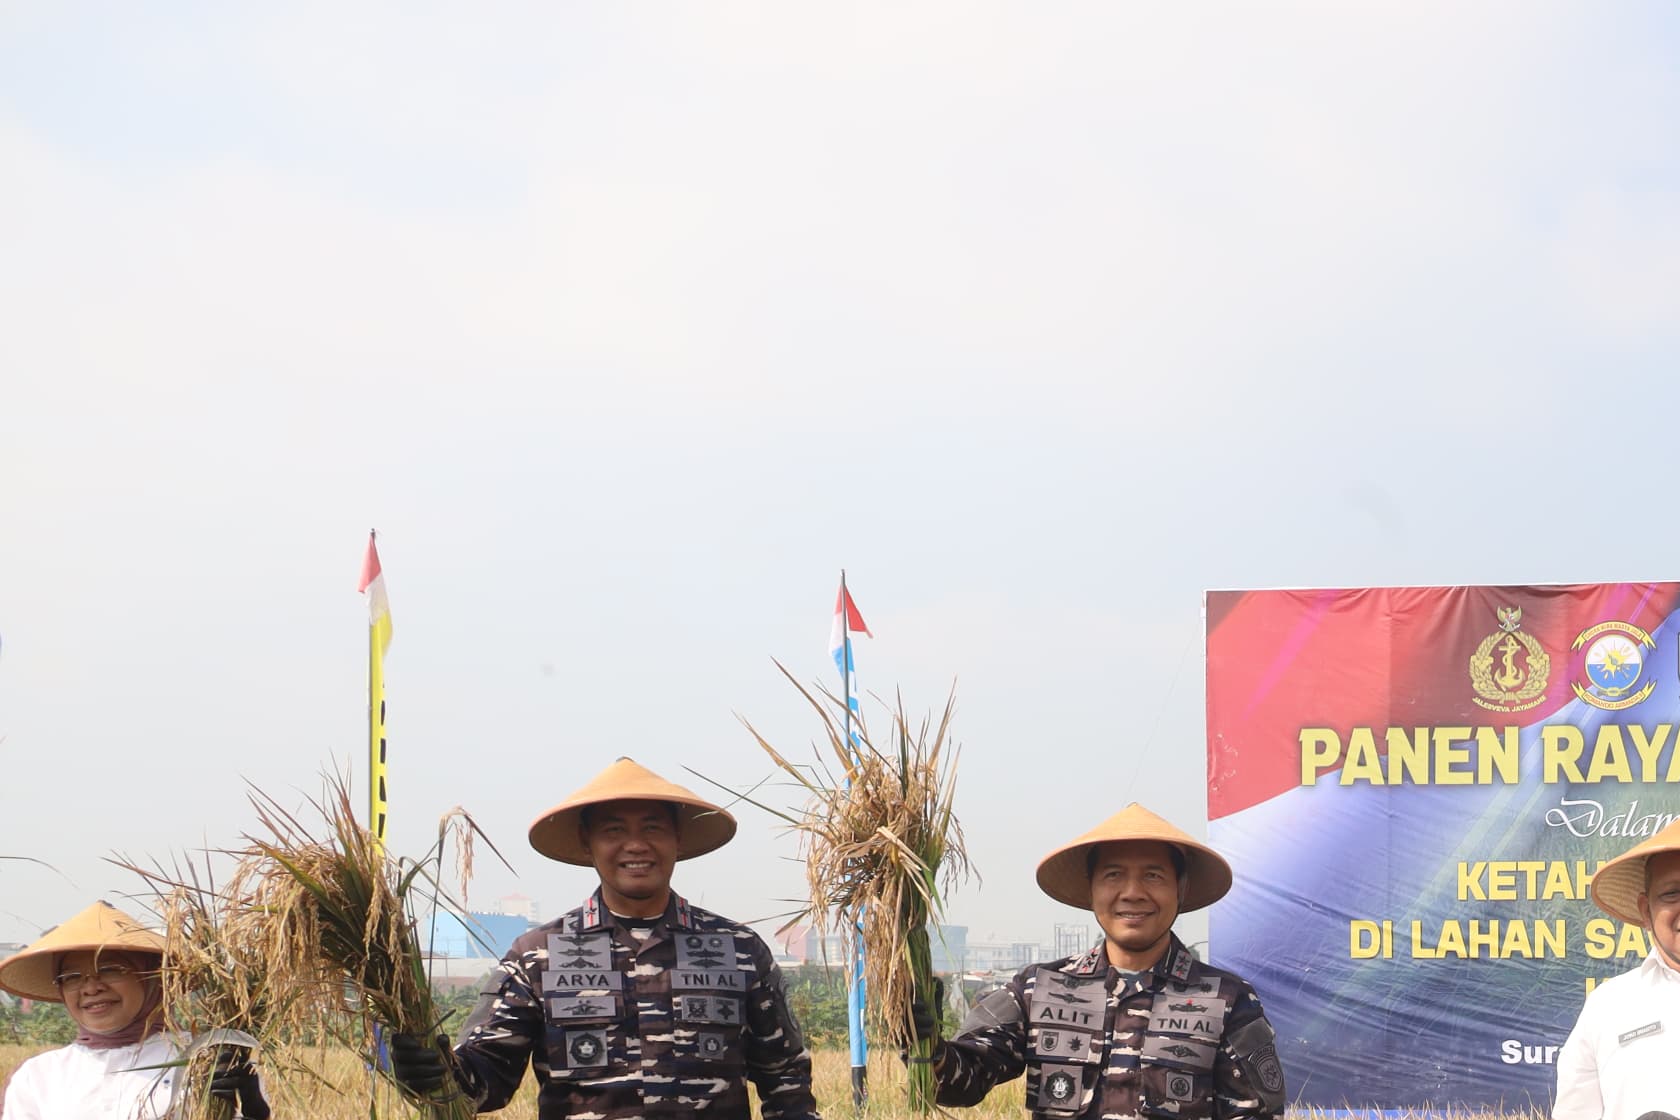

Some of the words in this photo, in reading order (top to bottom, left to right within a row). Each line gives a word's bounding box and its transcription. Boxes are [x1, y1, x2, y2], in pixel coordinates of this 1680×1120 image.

[1298, 726, 1520, 786] PANEN
[1350, 919, 1394, 960] DI
[1411, 918, 1567, 960] LAHAN
[557, 974, 609, 987] ARYA
[681, 973, 710, 986] TNI
[717, 974, 738, 987] AL
[1040, 1006, 1094, 1025] ALIT
[1157, 1018, 1188, 1030] TNI
[1193, 1019, 1214, 1034] AL
